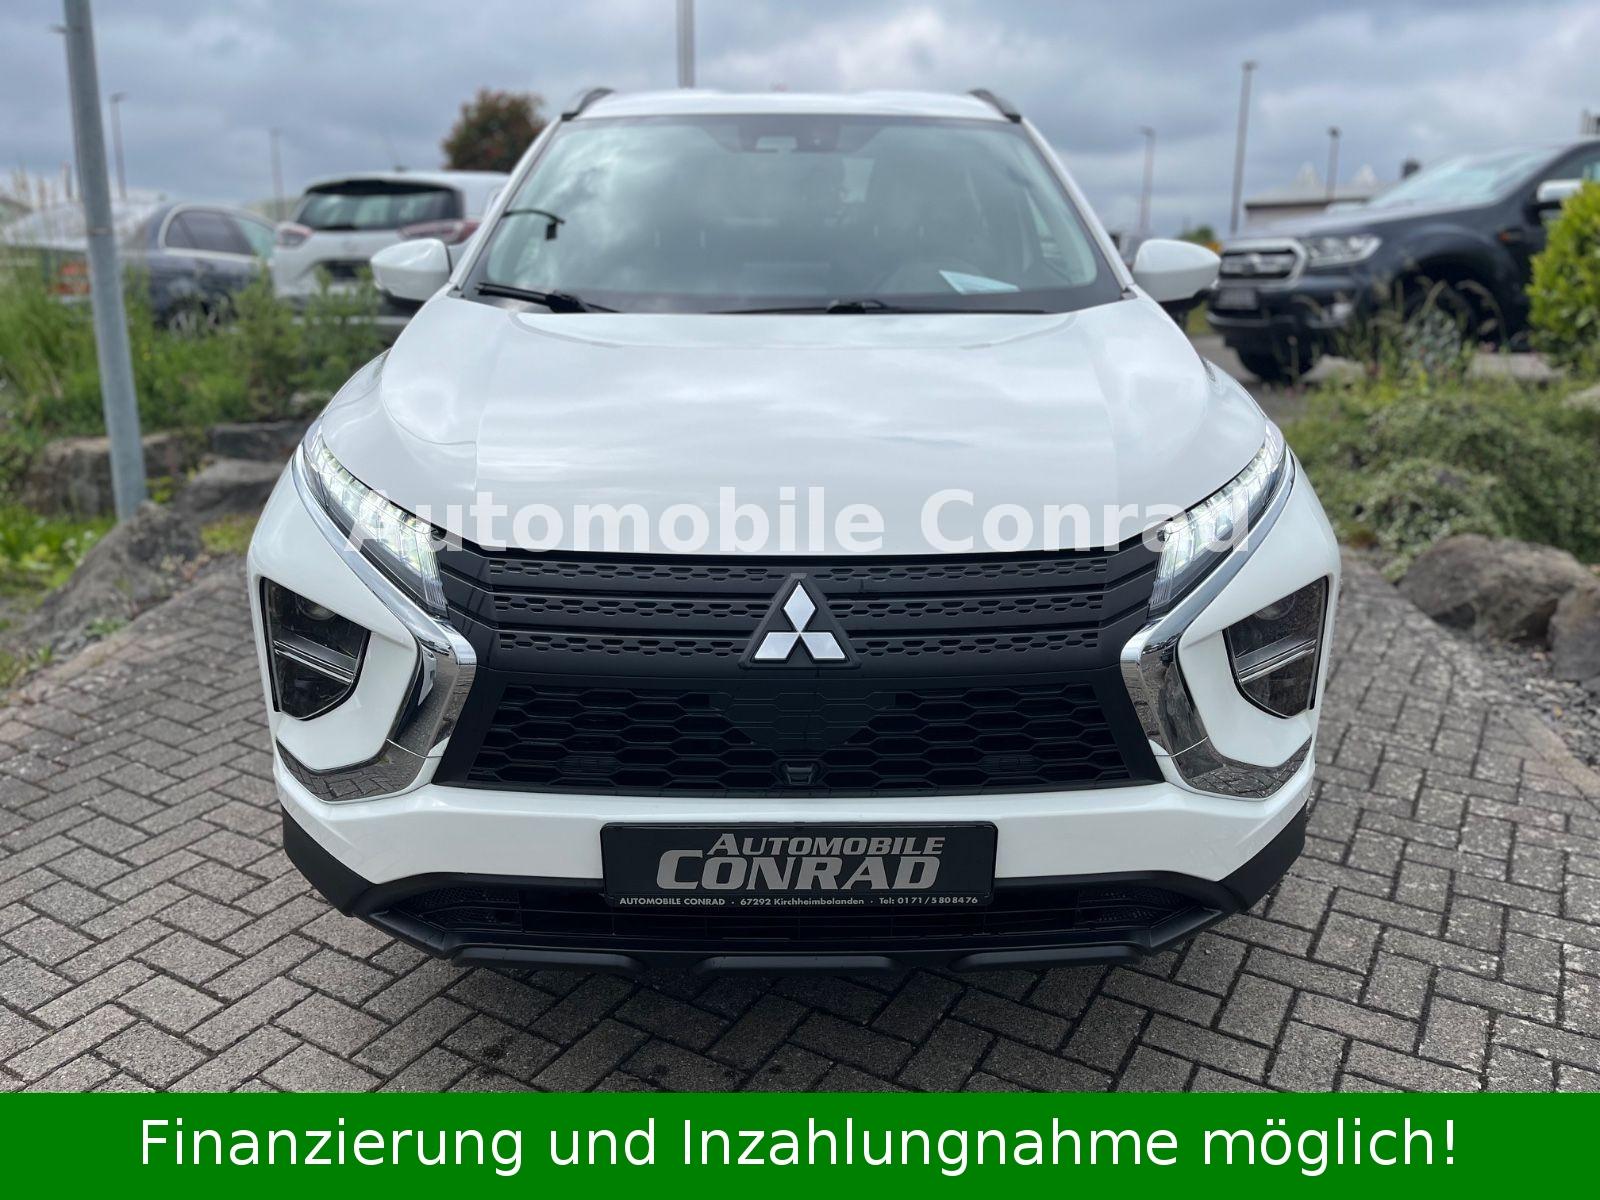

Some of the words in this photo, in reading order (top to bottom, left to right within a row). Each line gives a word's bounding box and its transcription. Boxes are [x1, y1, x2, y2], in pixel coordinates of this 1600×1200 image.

[707, 833, 946, 856] AUTOMOBILE
[656, 849, 941, 890] CONRAD
[619, 897, 681, 906] AUTOMOBILE
[684, 897, 726, 907] CONRAD
[740, 898, 771, 906] 67292
[774, 897, 864, 906] Kirchheimbolanden
[879, 896, 895, 905] Tel:
